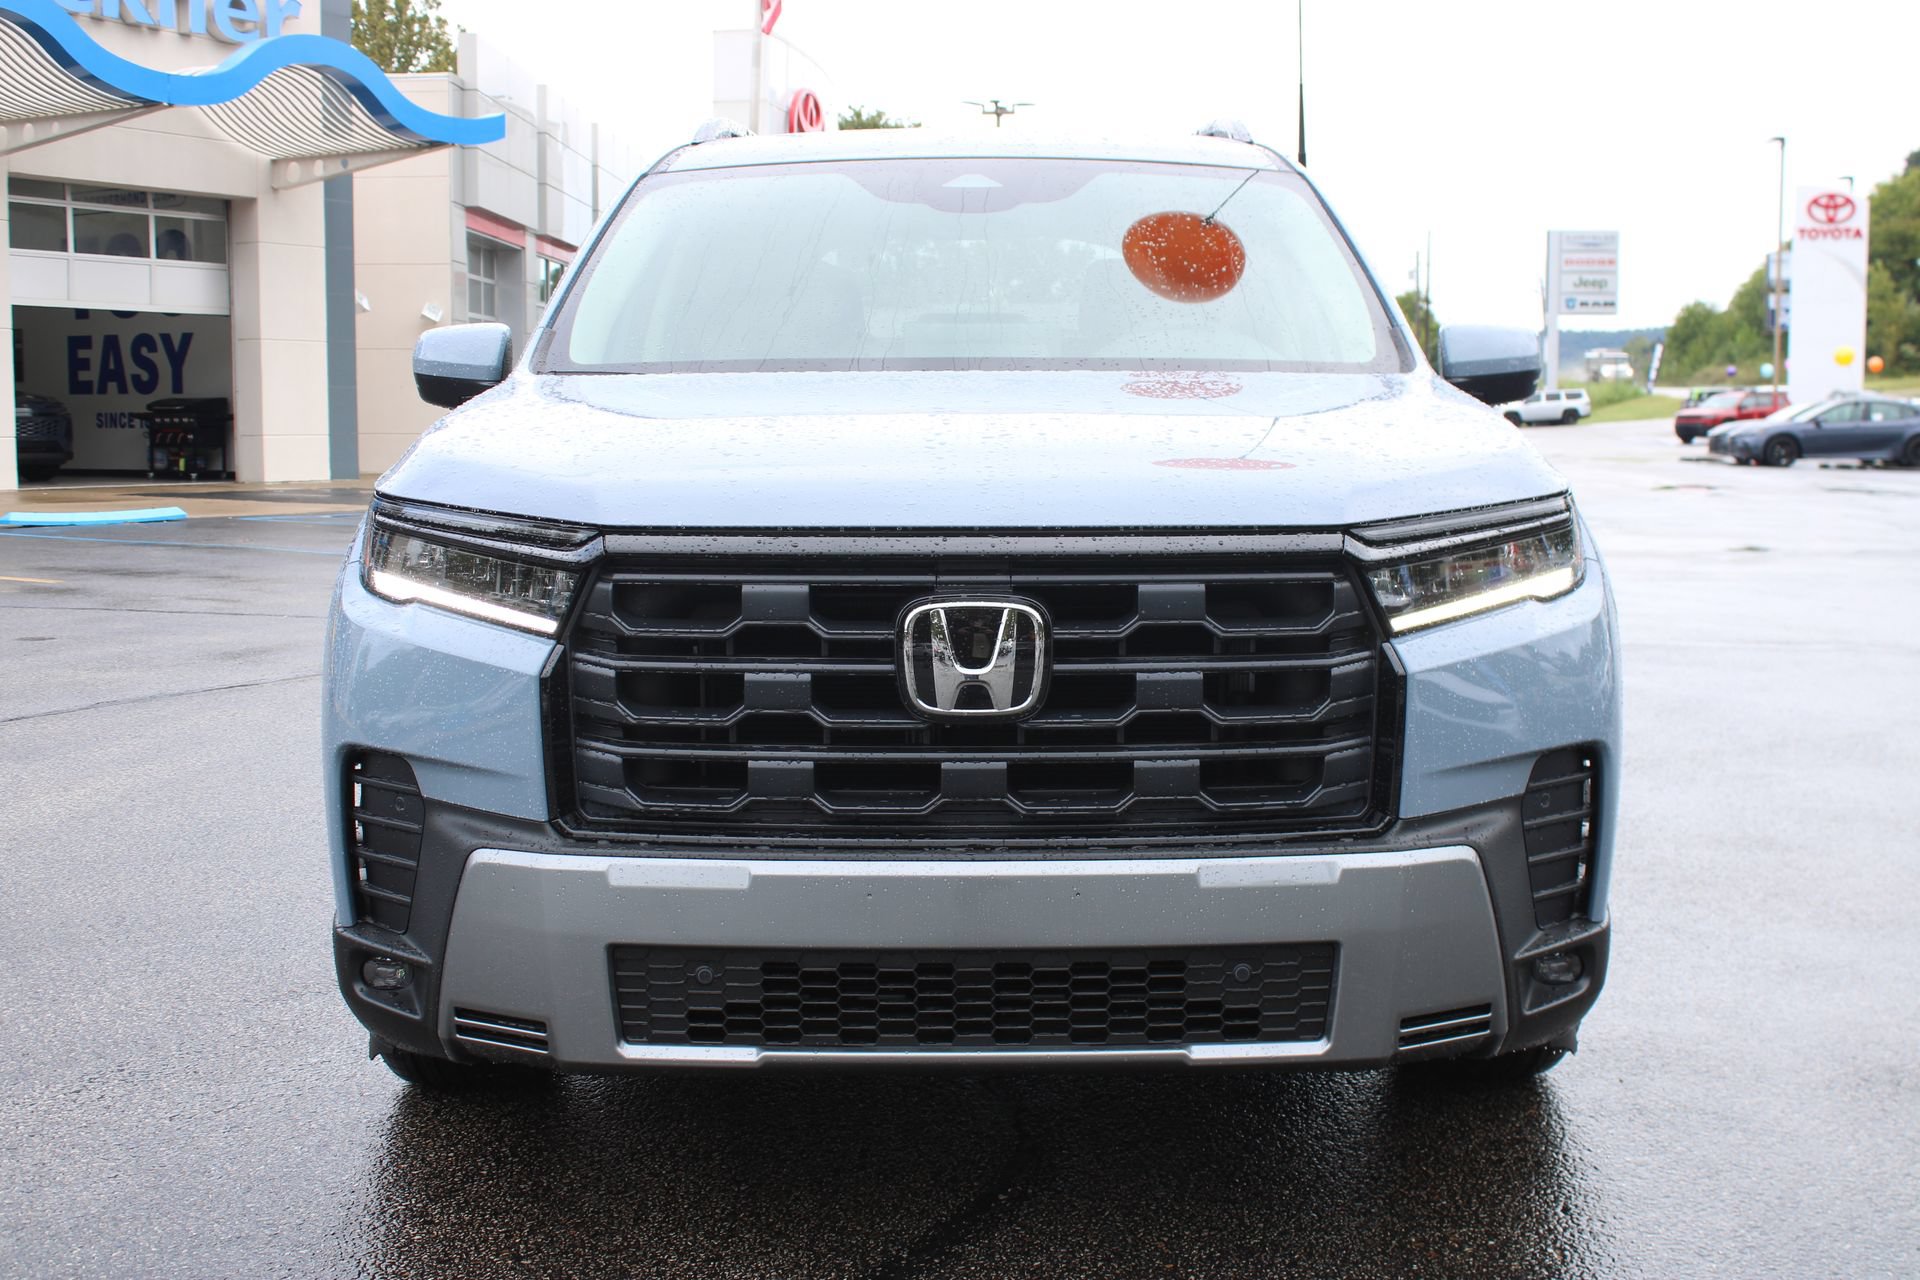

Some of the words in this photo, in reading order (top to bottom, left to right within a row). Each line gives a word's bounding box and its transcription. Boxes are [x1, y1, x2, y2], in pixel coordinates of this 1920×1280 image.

[1798, 228, 1863, 239] TOYOTA
[1573, 276, 1608, 290] Jeep
[67, 332, 194, 395] EASY
[96, 412, 135, 429] SINCE
